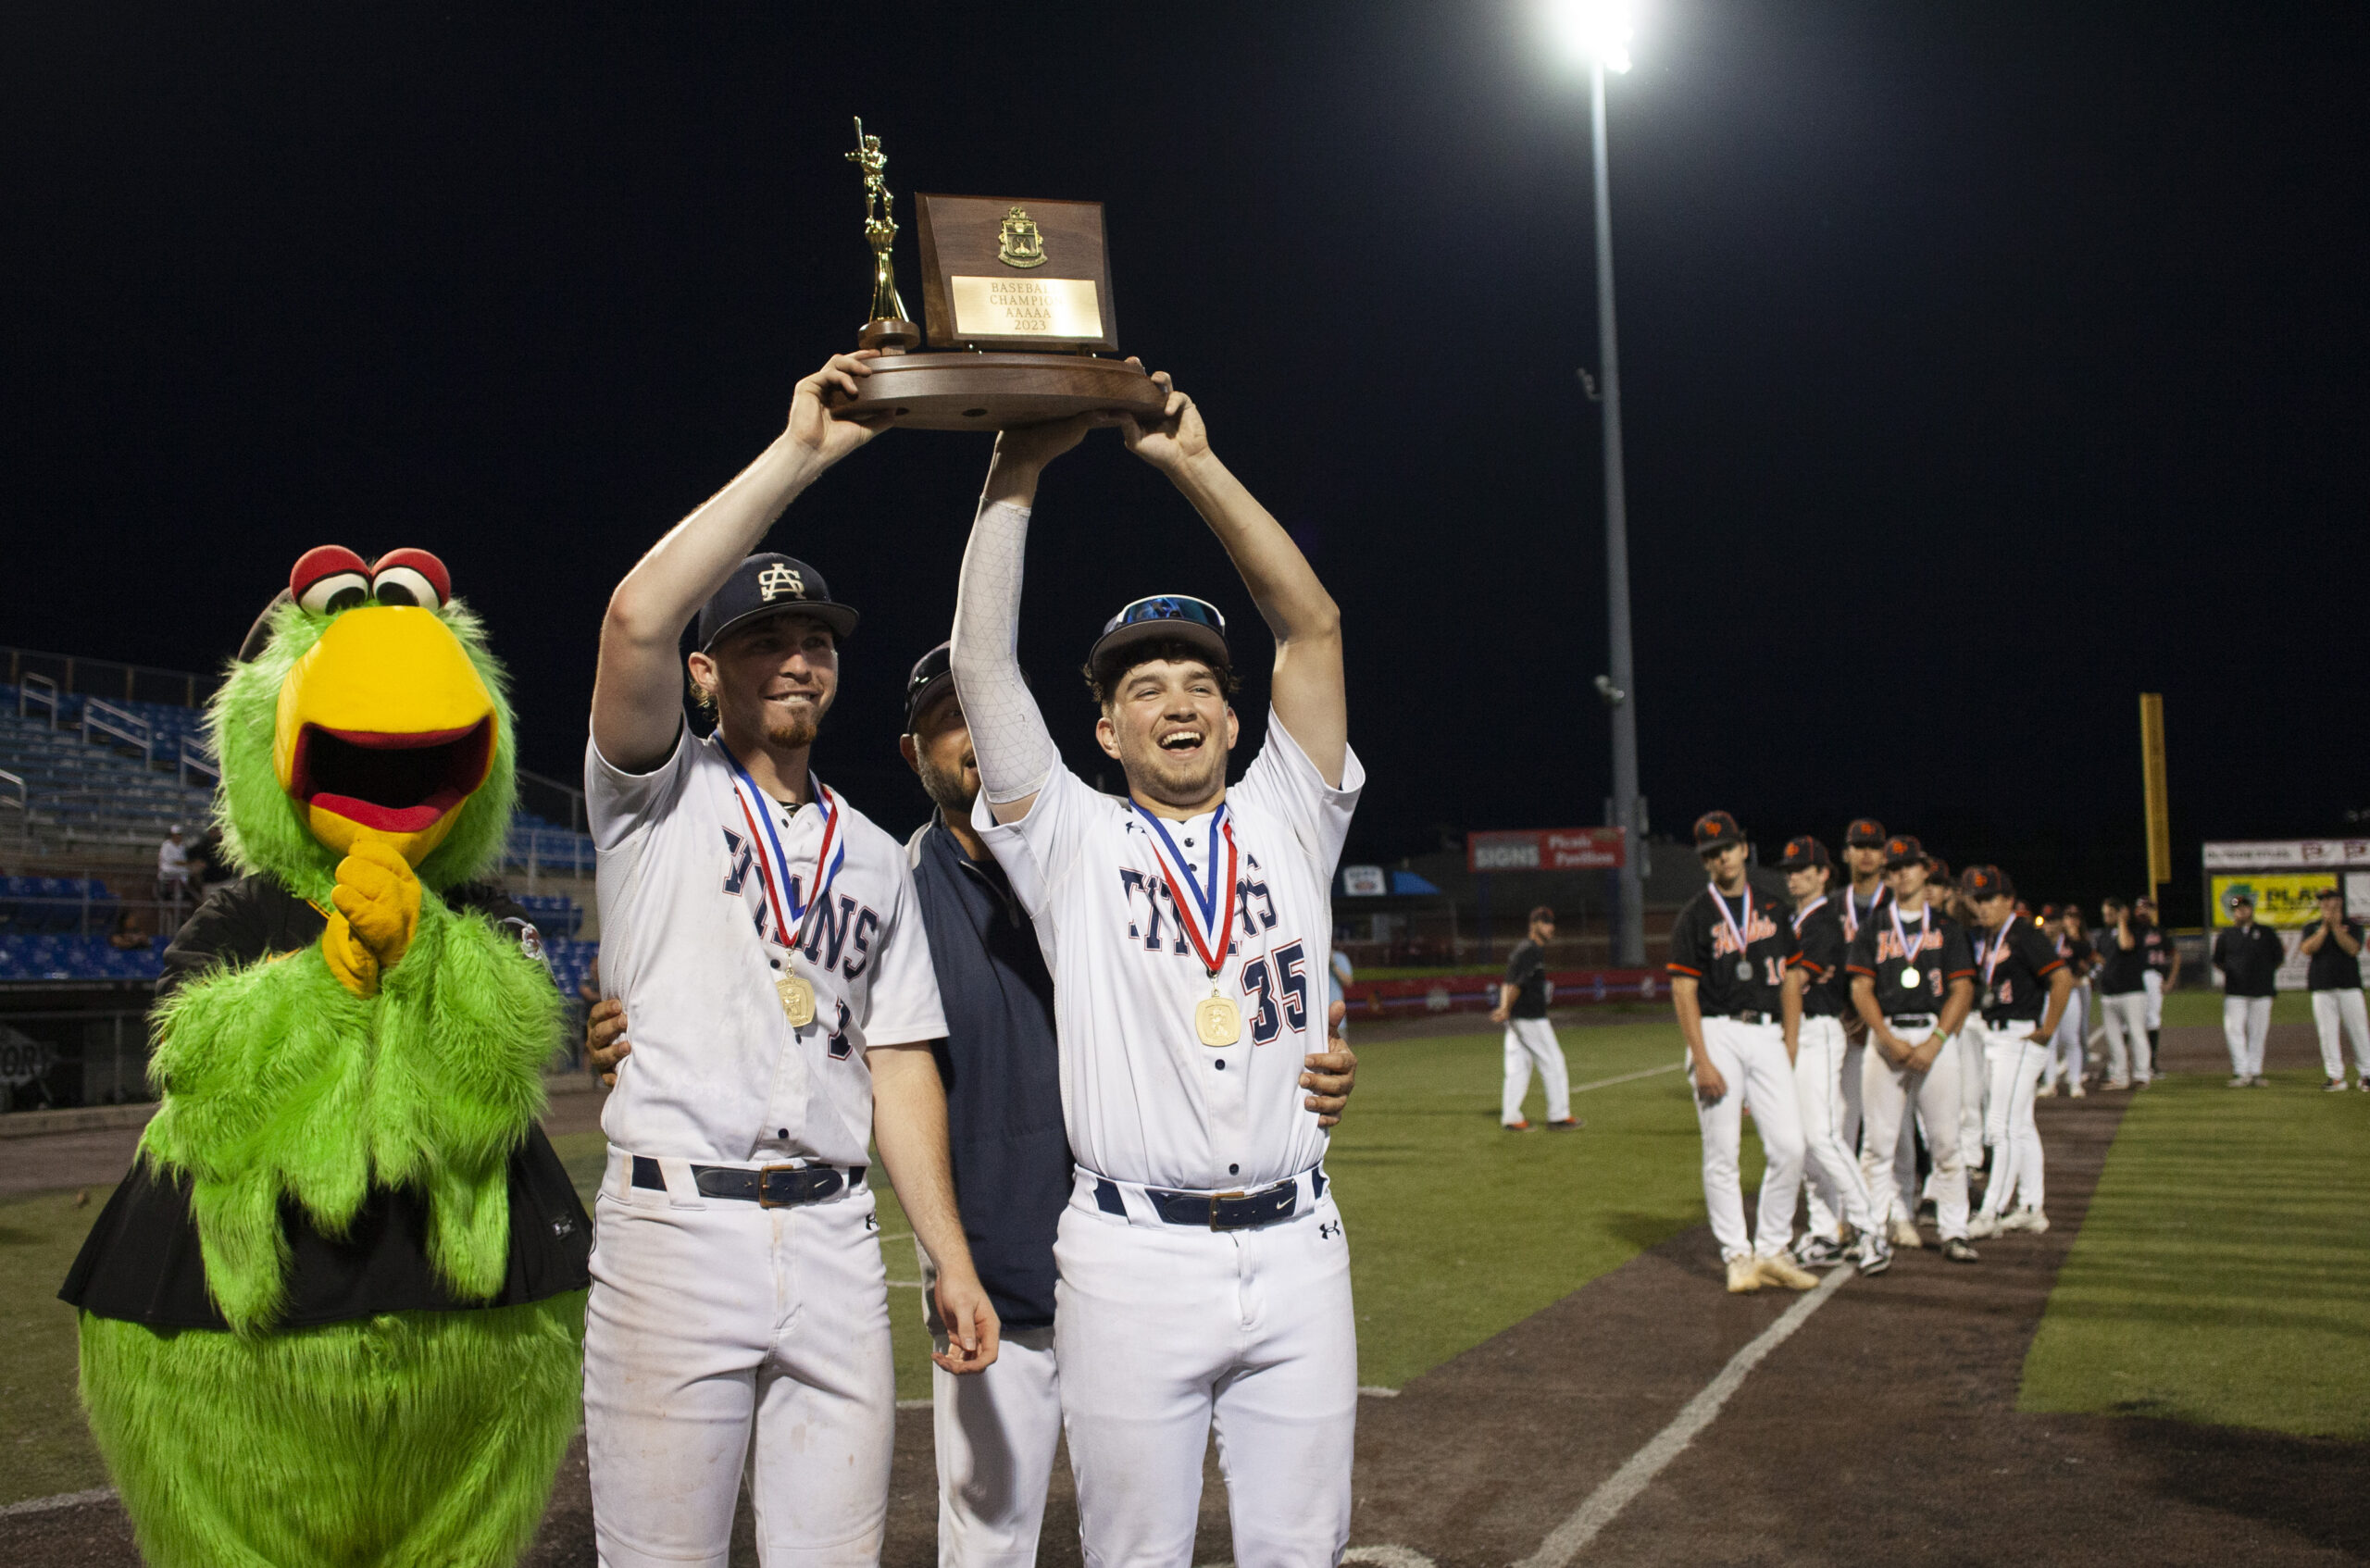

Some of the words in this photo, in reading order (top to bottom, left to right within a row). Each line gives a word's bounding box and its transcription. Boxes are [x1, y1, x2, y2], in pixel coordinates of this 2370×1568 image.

[1005, 307, 1052, 318] AAAAA
[1014, 319, 1047, 331] 2023
[1240, 938, 1308, 1047] 35
